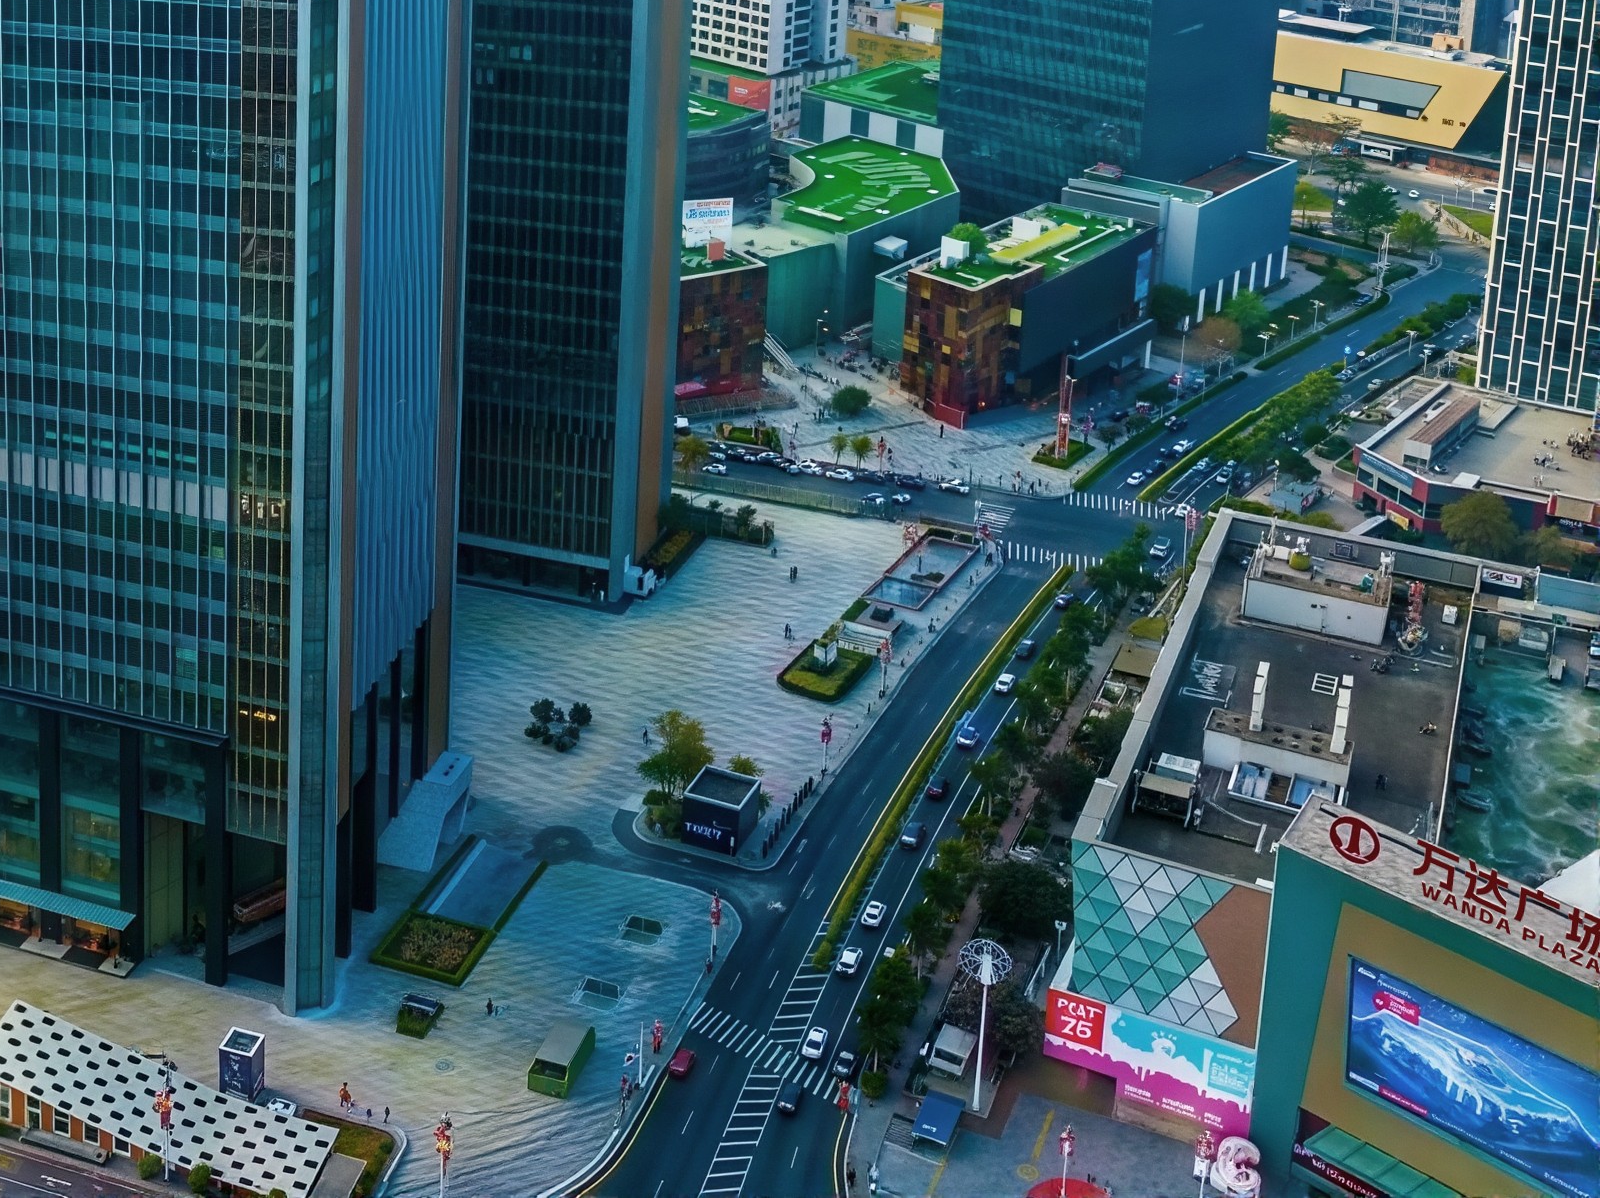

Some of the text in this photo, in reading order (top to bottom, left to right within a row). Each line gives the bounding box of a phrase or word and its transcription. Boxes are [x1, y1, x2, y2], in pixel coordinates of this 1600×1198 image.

[1412, 838, 1600, 958] 万达广场
[1421, 882, 1600, 975] WANDA PLAZA
